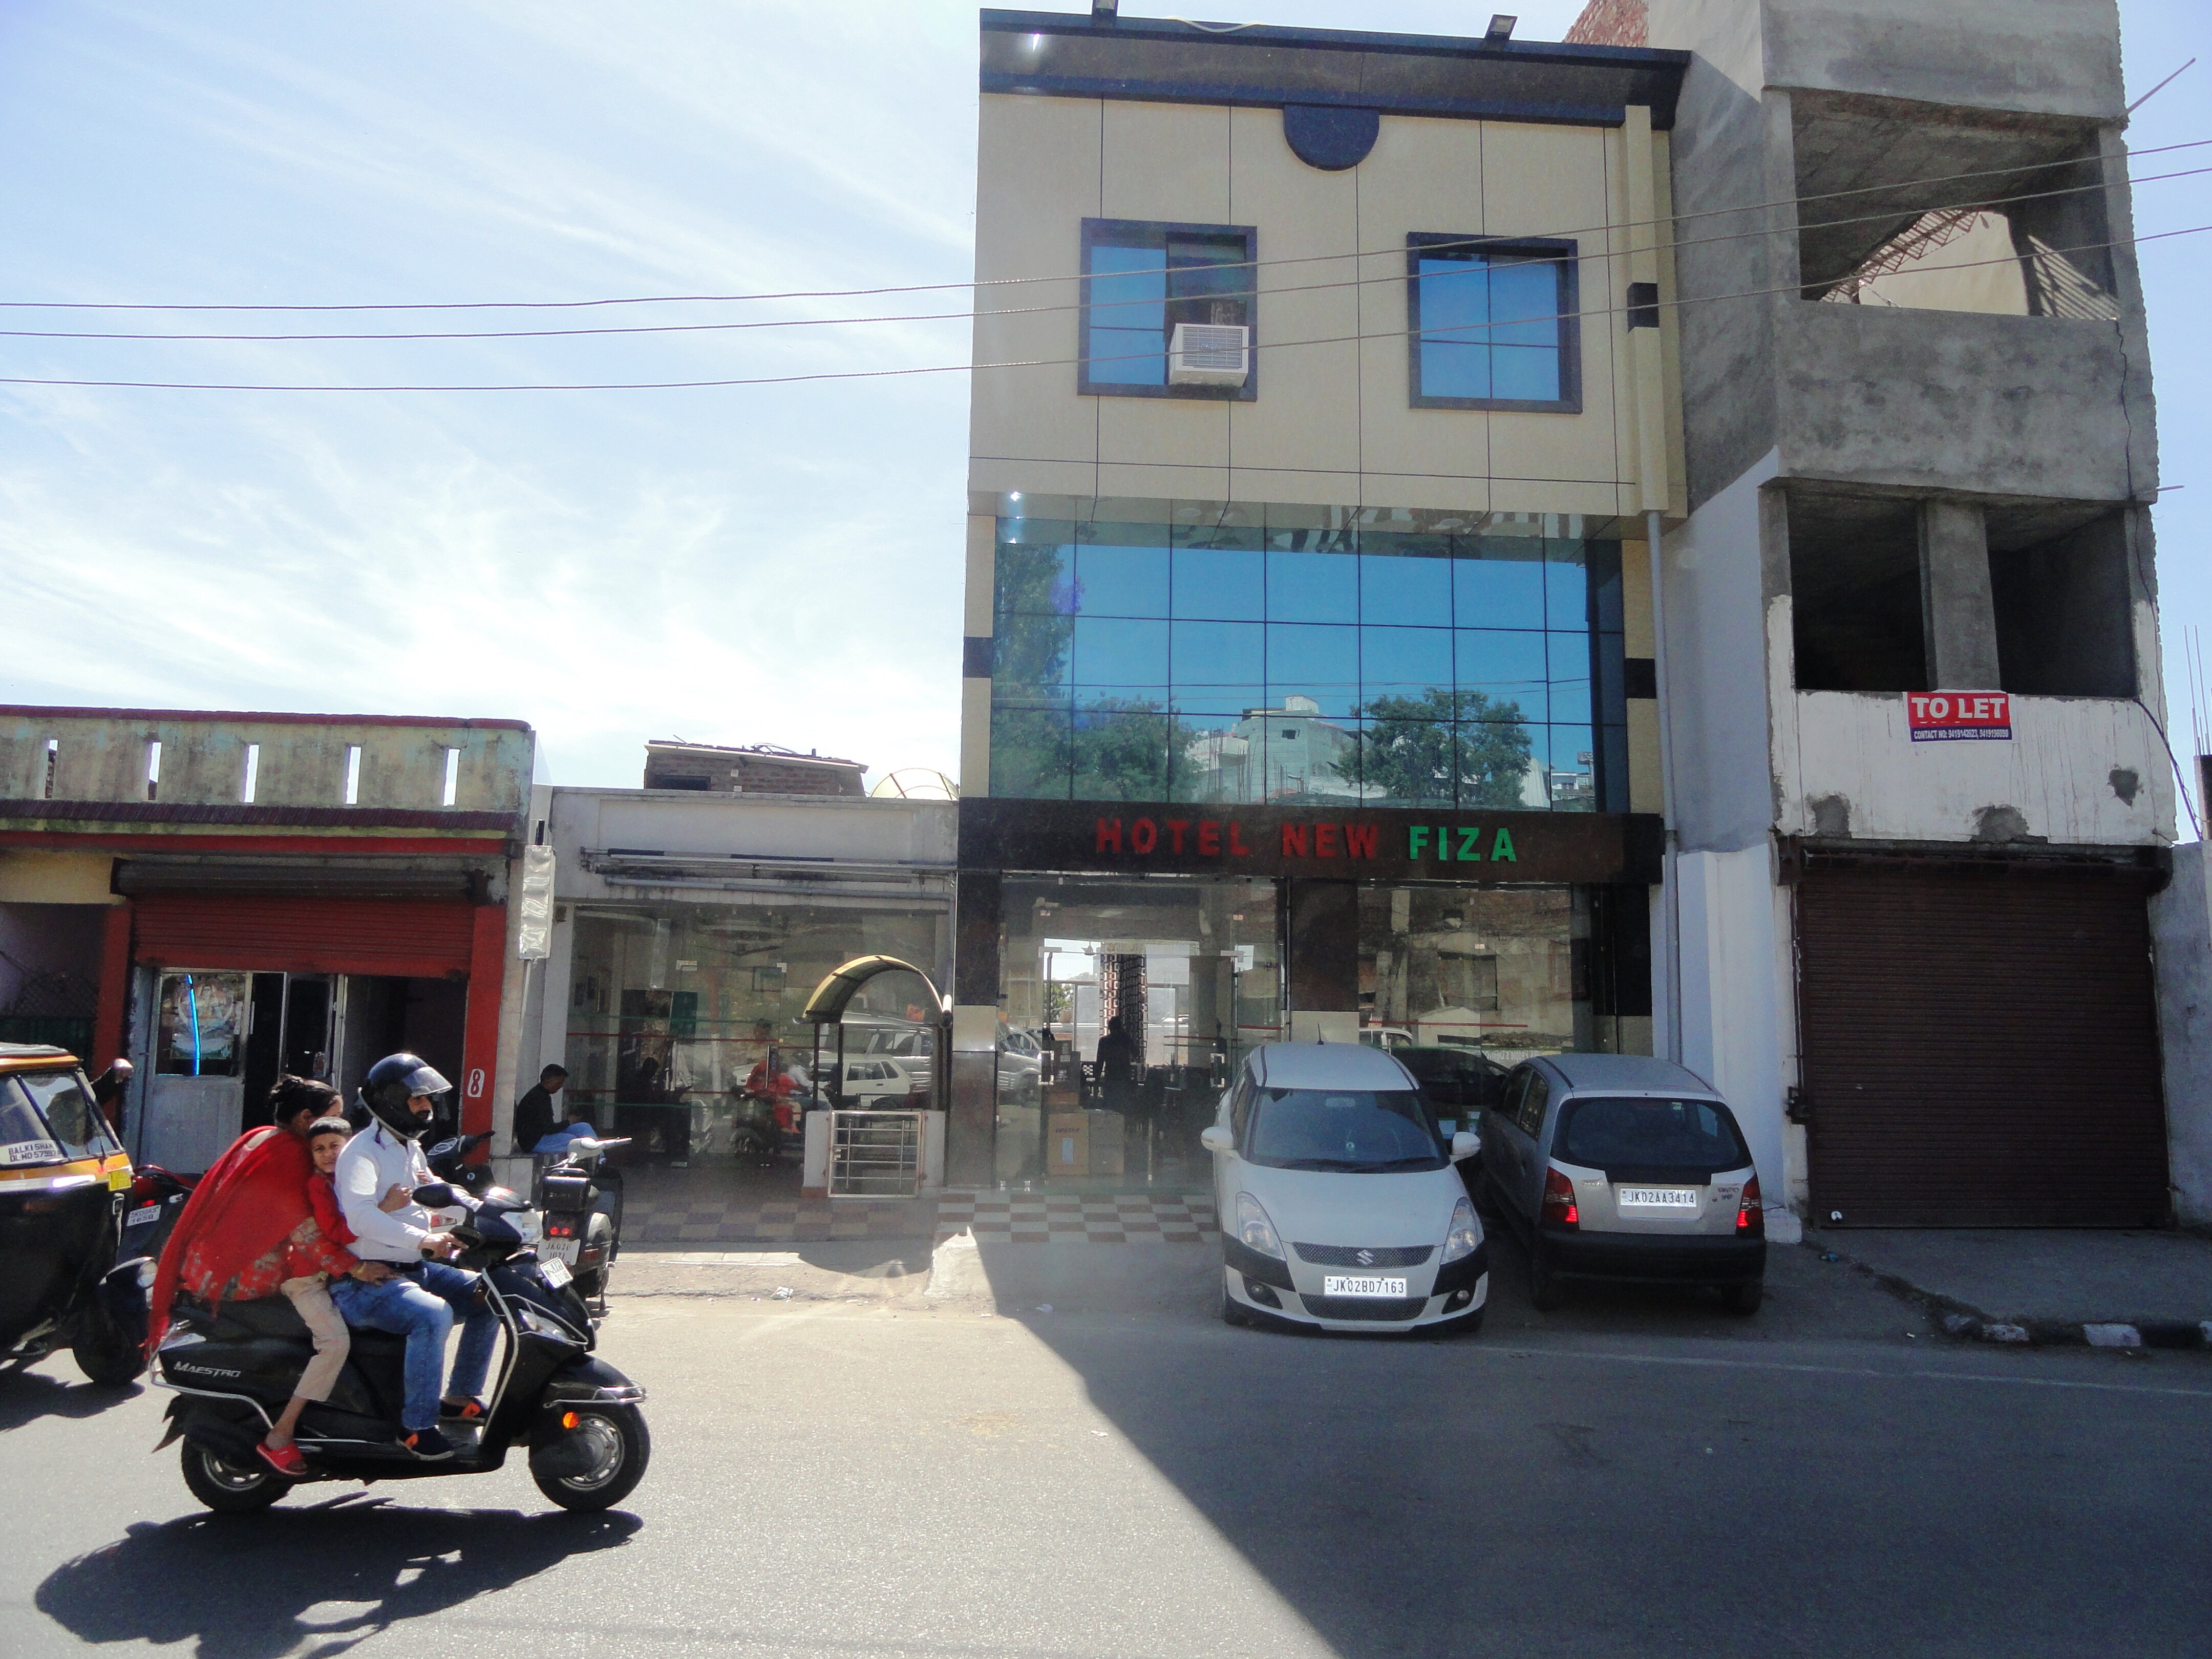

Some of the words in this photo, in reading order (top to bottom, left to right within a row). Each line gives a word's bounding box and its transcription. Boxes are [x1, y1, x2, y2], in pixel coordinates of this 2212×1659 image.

[1911, 697, 1949, 718] TO
[1958, 698, 2005, 718] LET
[1913, 730, 1937, 739] CONTACT
[1096, 817, 1250, 856] HOTEL
[1282, 822, 1379, 859] NEW
[1409, 825, 1517, 862] FIZA
[471, 1070, 481, 1095] 8
[1628, 1191, 1694, 1204] JK02AA3414
[1333, 1279, 1404, 1293] JK02BD7163
[174, 1361, 241, 1377] MAESTRO
